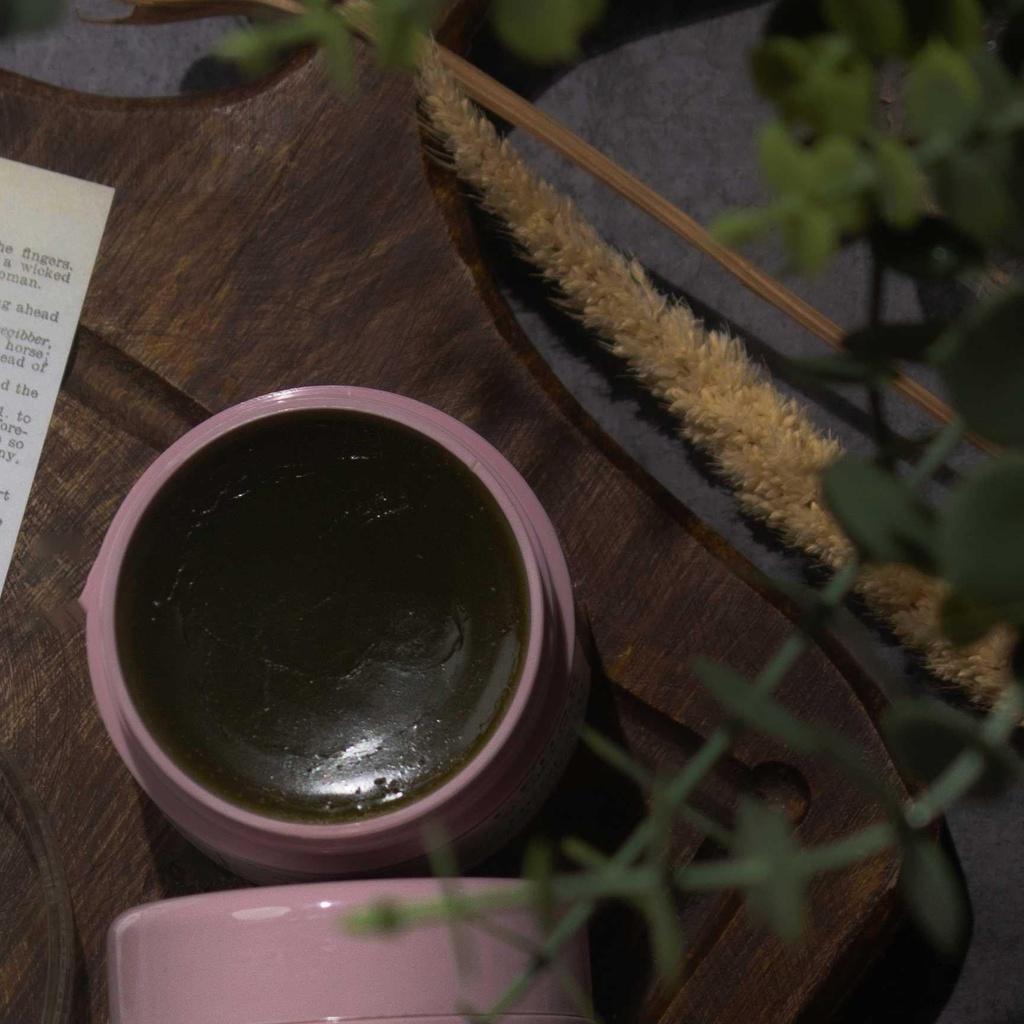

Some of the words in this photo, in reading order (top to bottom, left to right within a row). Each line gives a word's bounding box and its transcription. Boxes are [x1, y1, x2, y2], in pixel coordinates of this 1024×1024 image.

[21, 263, 71, 283] wicked
[16, 303, 59, 322] ahead
[31, 362, 48, 373] of
[15, 383, 38, 398] the
[7, 438, 24, 449] so
